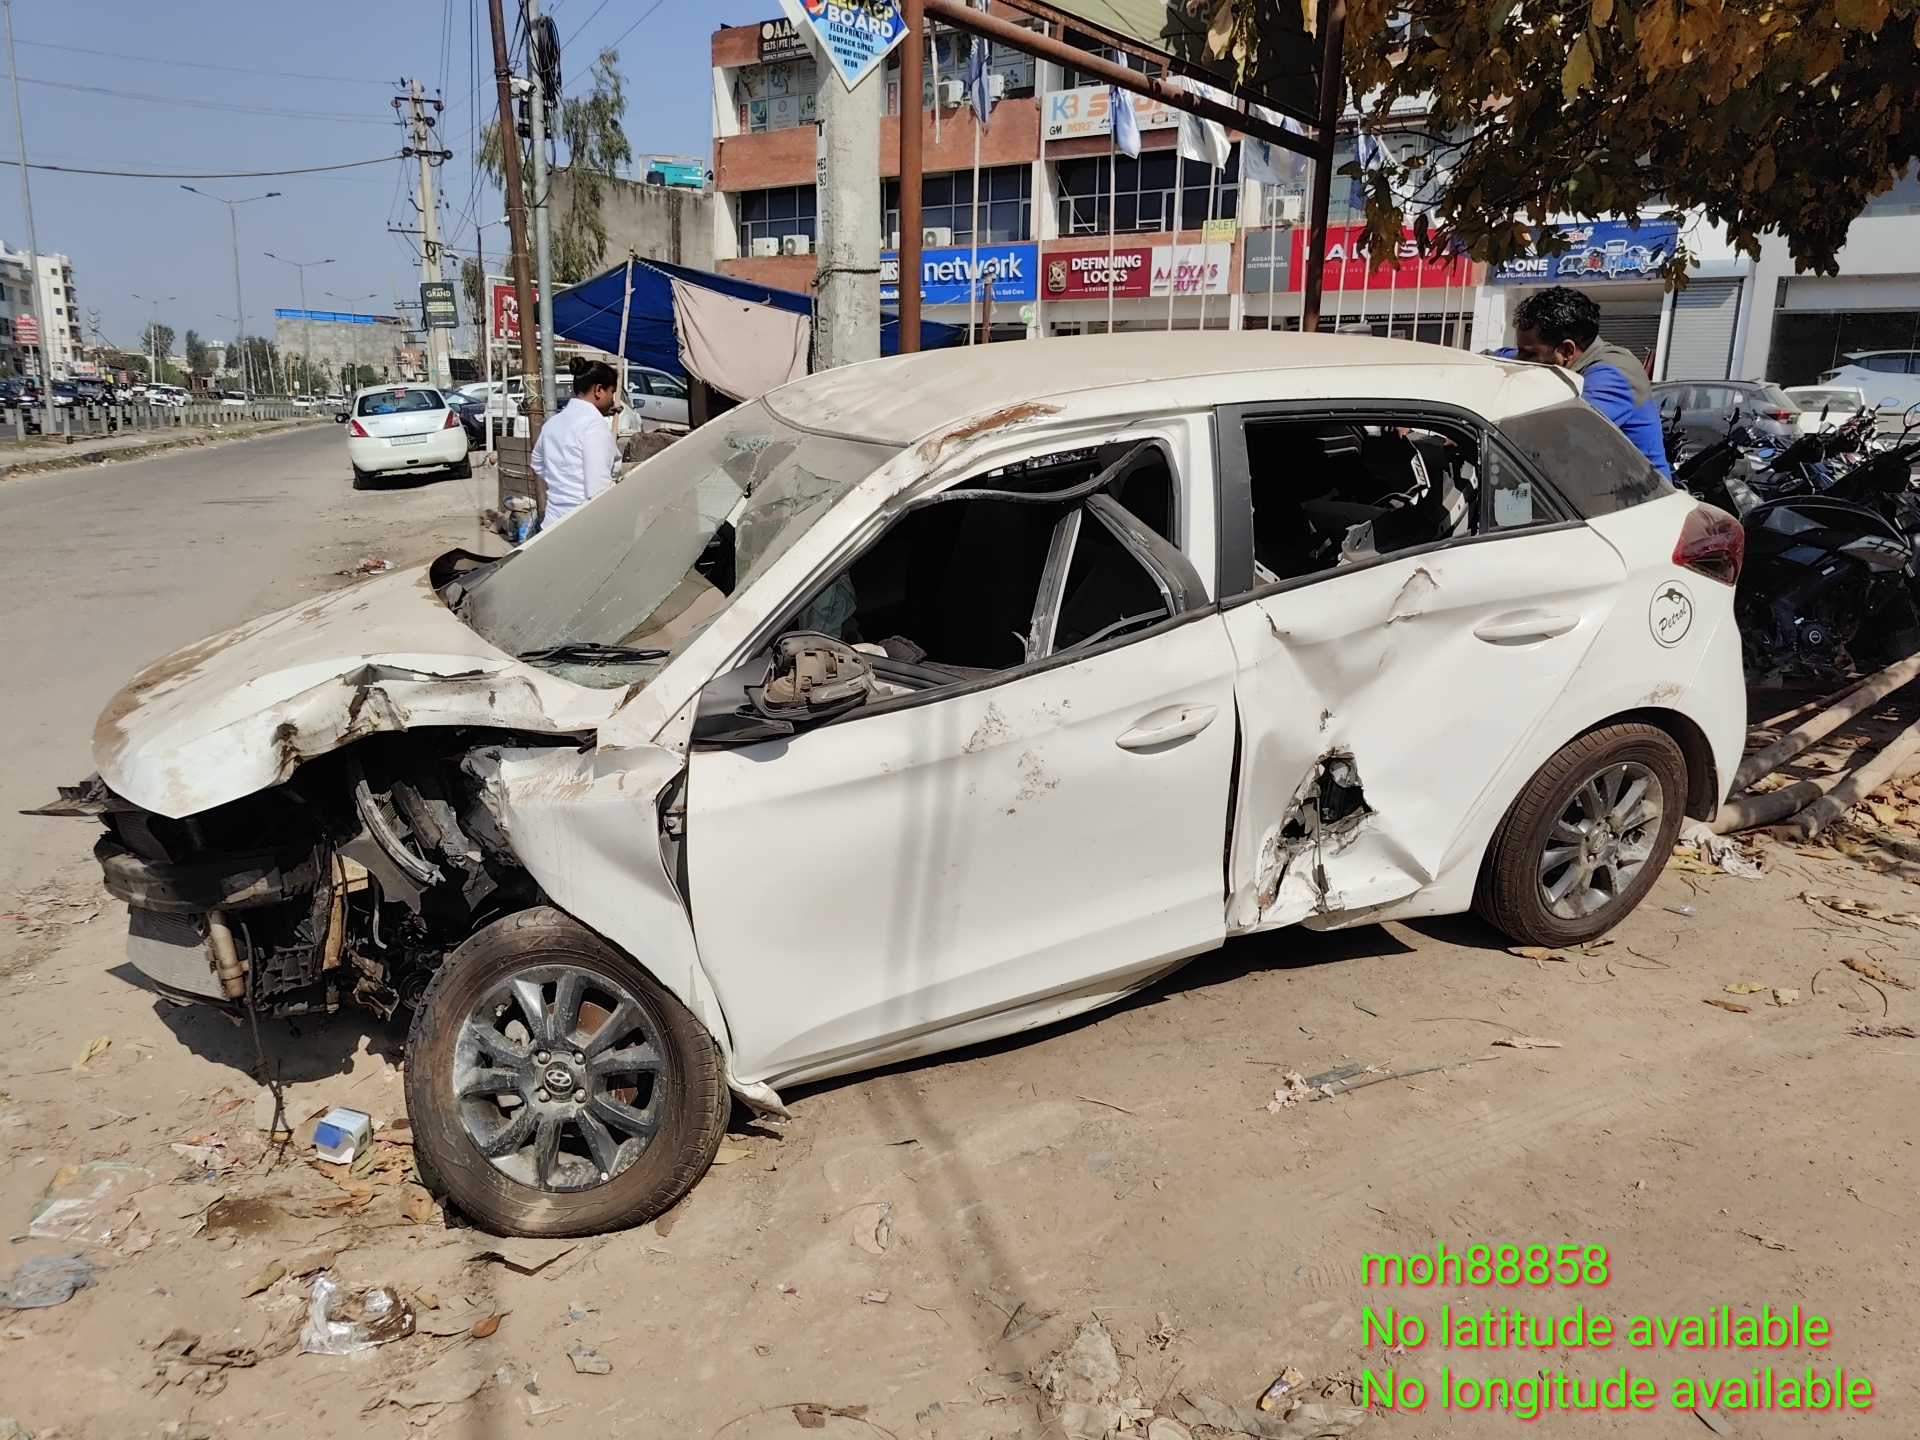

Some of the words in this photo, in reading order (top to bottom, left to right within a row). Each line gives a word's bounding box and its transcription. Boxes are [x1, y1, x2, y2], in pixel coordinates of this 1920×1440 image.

[827, 4, 893, 38] BOARD
[829, 22, 844, 35] FLEX
[844, 26, 874, 43] PRINTING
[763, 40, 776, 51] IELTS
[778, 39, 789, 49] PTE
[828, 33, 856, 49] SUNPACK
[833, 46, 852, 57] ONEWAY
[852, 51, 868, 61] VISION
[843, 58, 858, 69] NEON
[923, 251, 1024, 283] network
[1071, 254, 1142, 271] DEFINNING
[1083, 270, 1128, 284] LOCKS
[1154, 264, 1219, 280] AADYA'S
[1496, 271, 1547, 279] AUTOMOBILES
[1173, 280, 1200, 292] HUT
[426, 290, 451, 298] GRAND
[1659, 601, 1687, 636] Petrol
